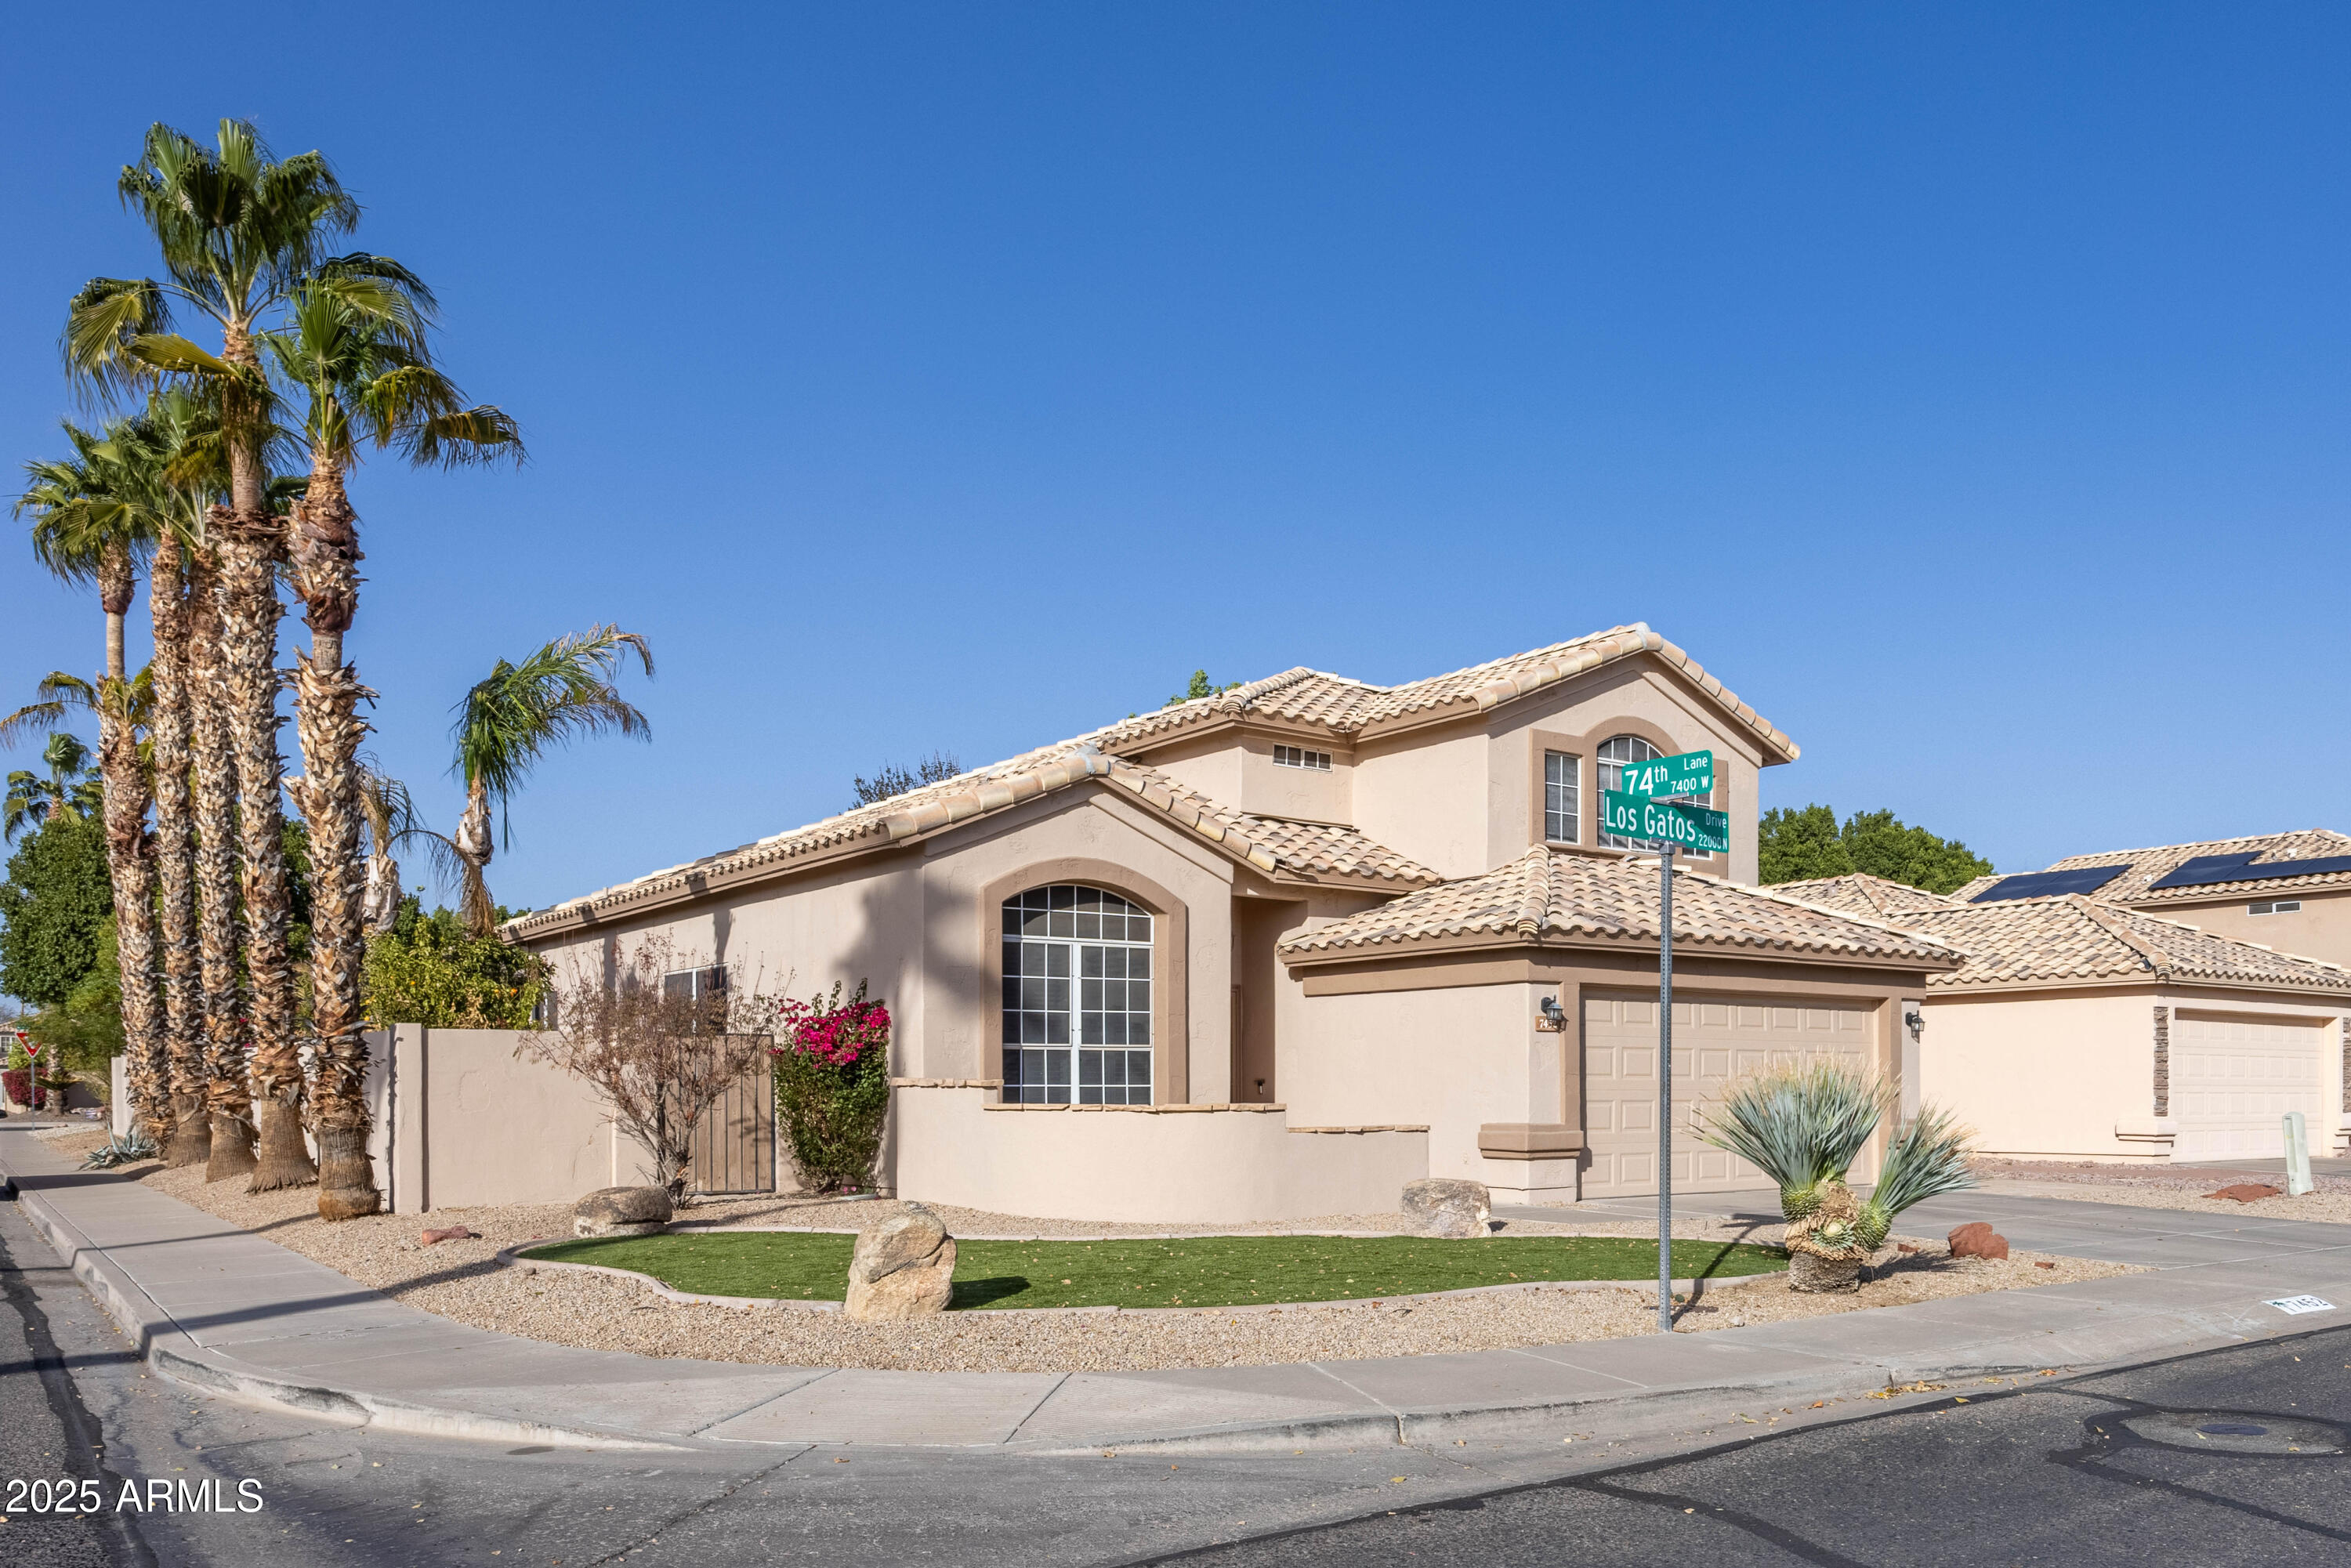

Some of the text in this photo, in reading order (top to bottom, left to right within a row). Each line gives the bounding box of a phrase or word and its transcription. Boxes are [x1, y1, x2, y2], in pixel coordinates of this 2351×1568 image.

[1625, 756, 1708, 795] 74th Lane
[1670, 775, 1709, 794] 7400 W
[1606, 796, 1727, 842] Los Gatos Drive
[1698, 833, 1728, 850] 22000 N
